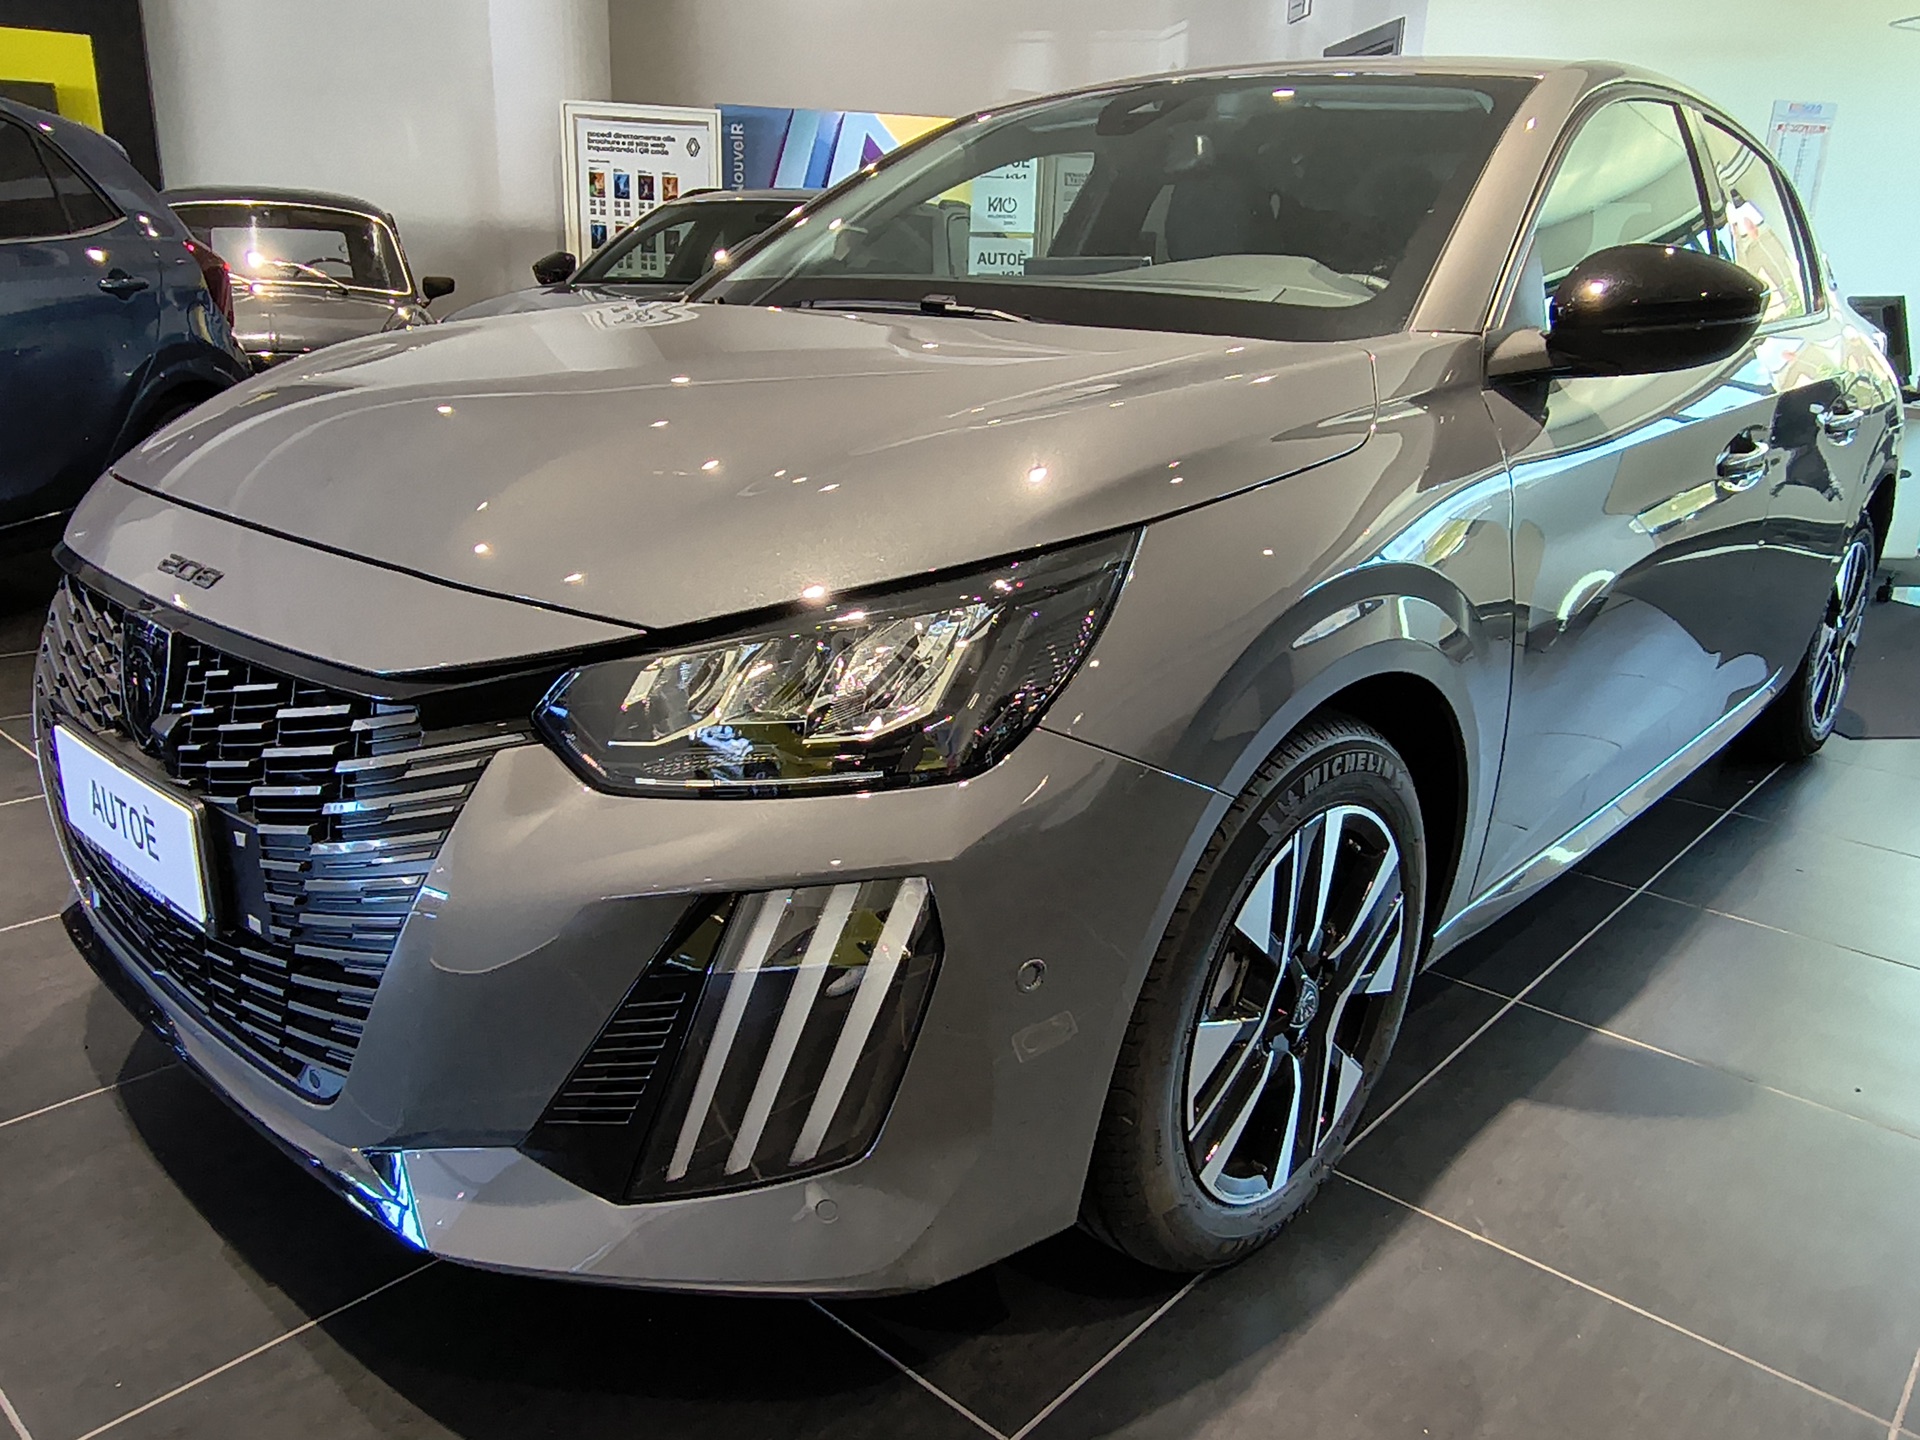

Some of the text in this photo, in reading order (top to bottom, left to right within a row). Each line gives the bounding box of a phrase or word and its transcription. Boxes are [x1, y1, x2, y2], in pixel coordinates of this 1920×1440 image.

[977, 250, 1026, 266] AUTOÈ
[157, 553, 225, 590] 208
[1303, 752, 1394, 796] MICHELIN
[91, 779, 160, 862] AUTOÈ
